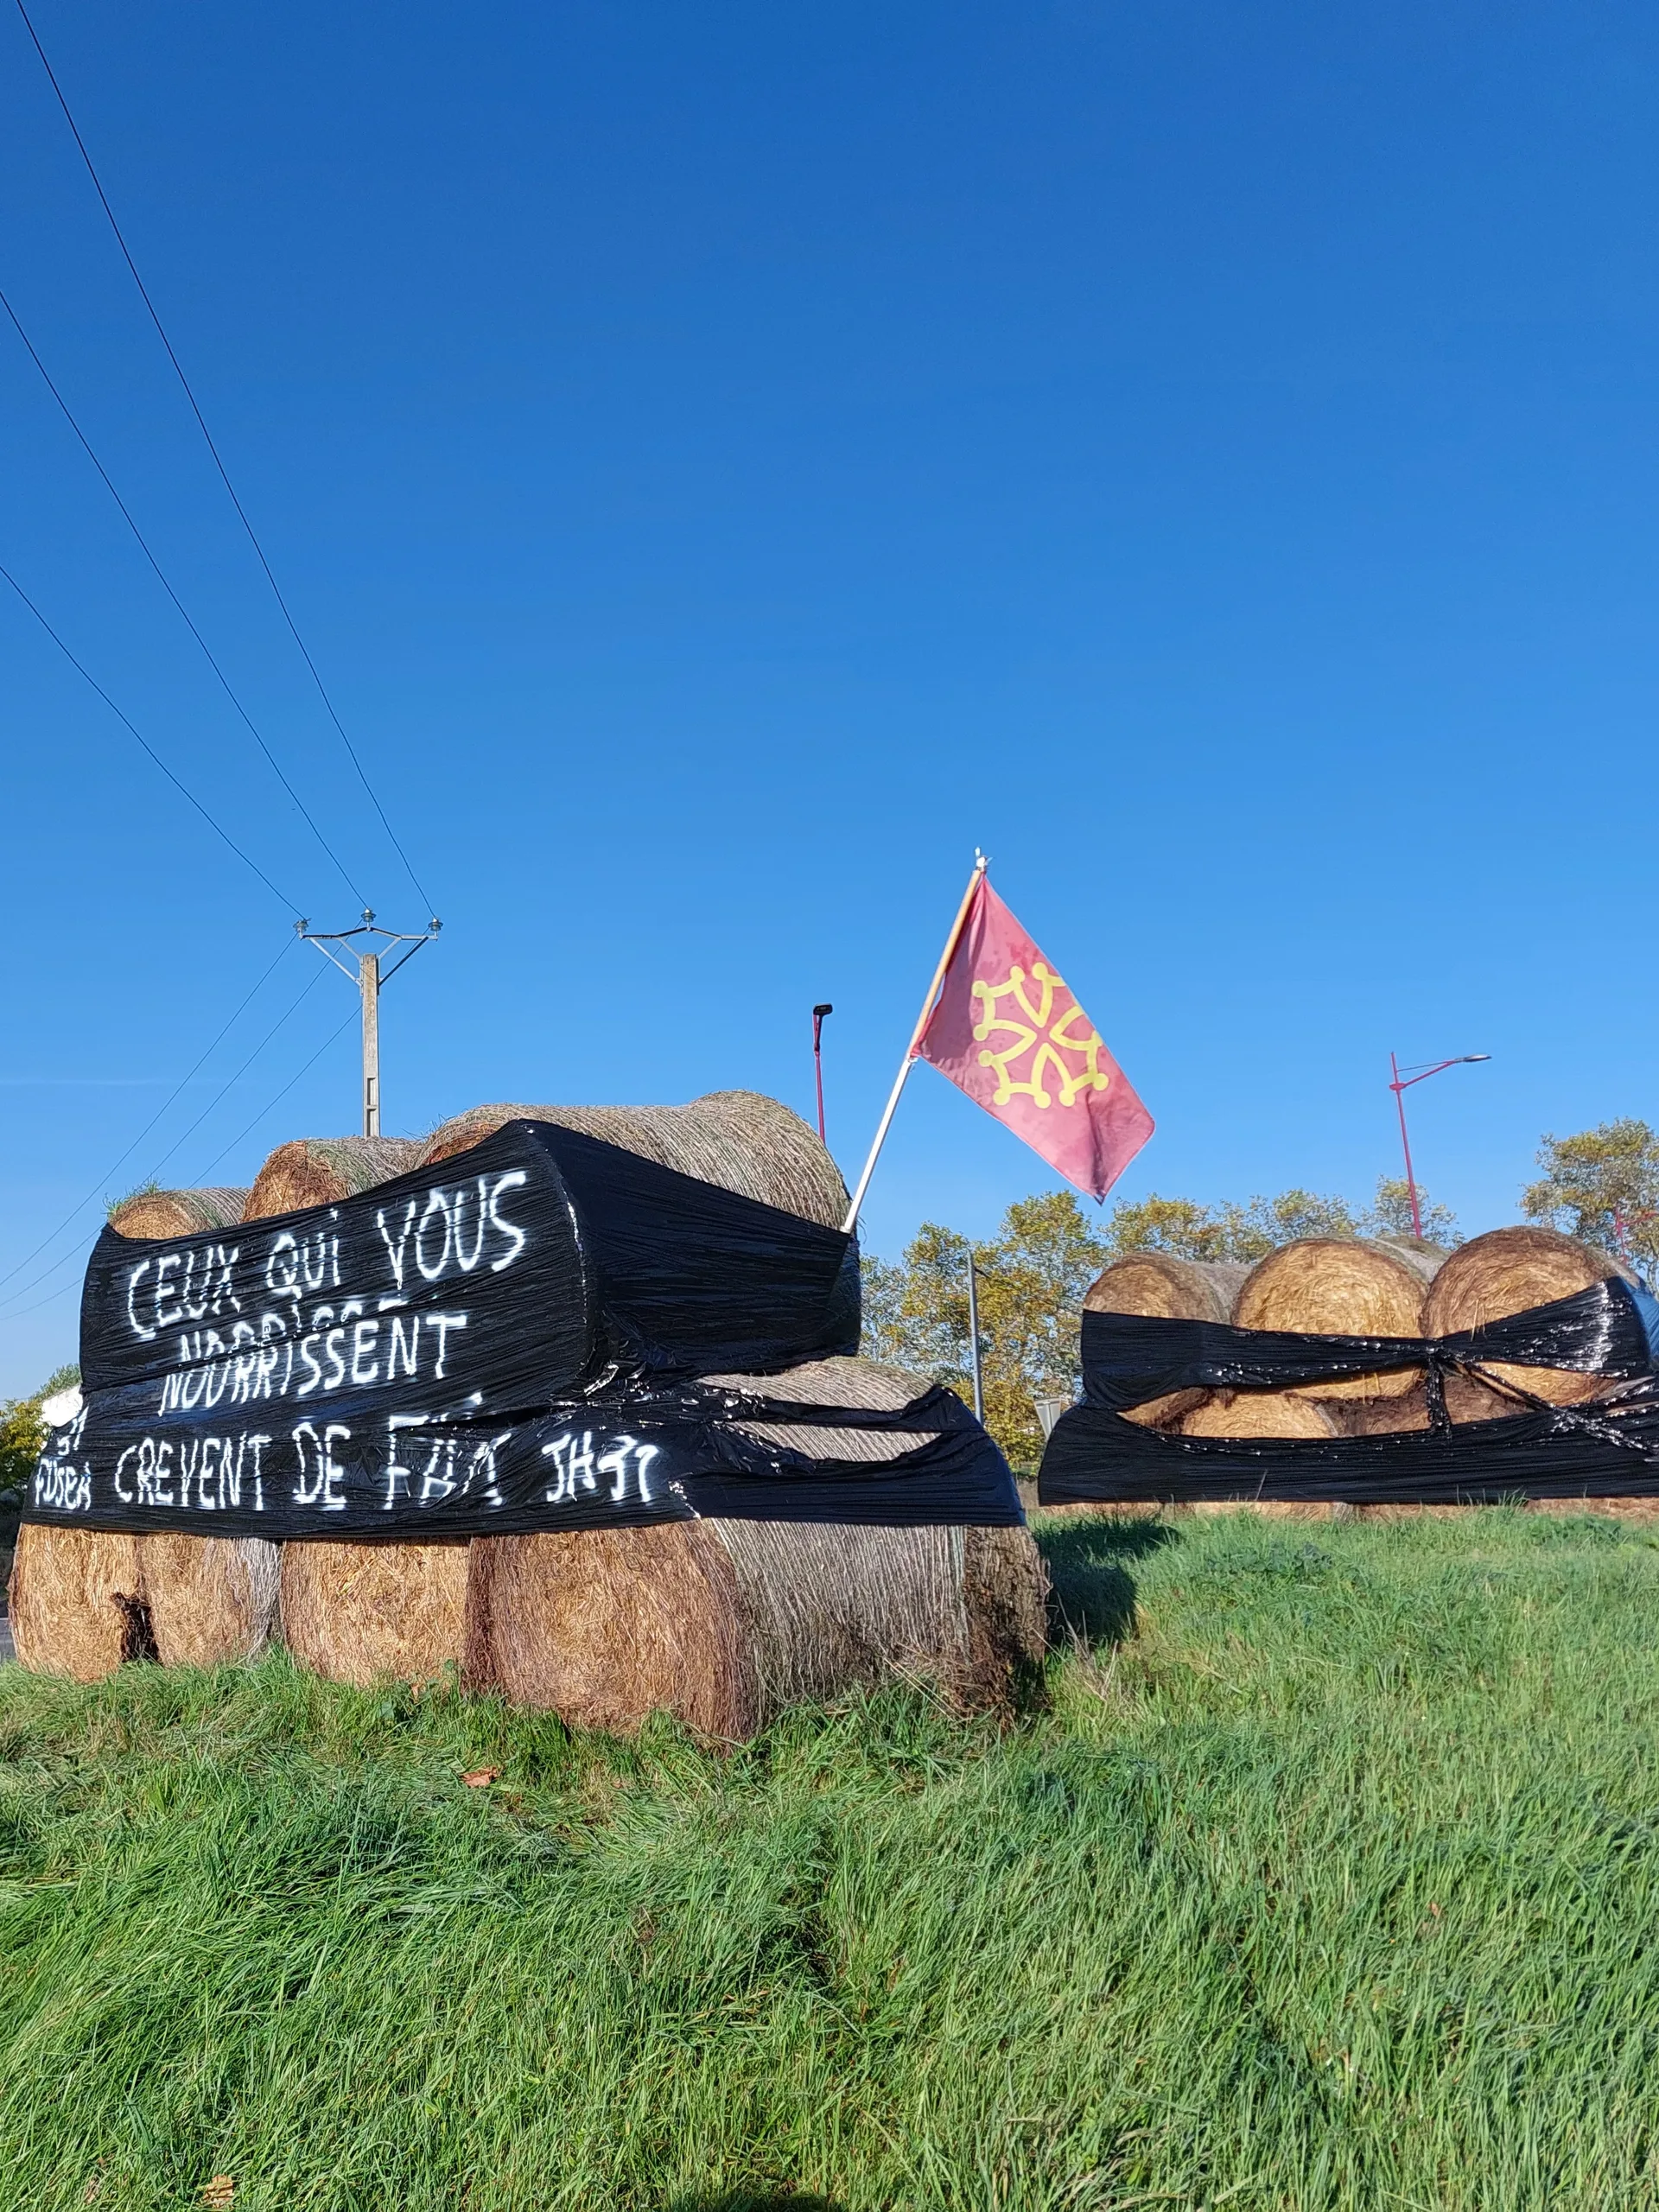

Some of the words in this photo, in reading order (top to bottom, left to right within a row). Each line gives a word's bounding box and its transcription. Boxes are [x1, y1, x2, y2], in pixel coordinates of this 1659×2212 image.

[127, 1243, 241, 1339] CEUX
[377, 1170, 527, 1289] VOUS
[115, 1431, 272, 1511] CREVENT
[291, 1421, 352, 1509] DE
